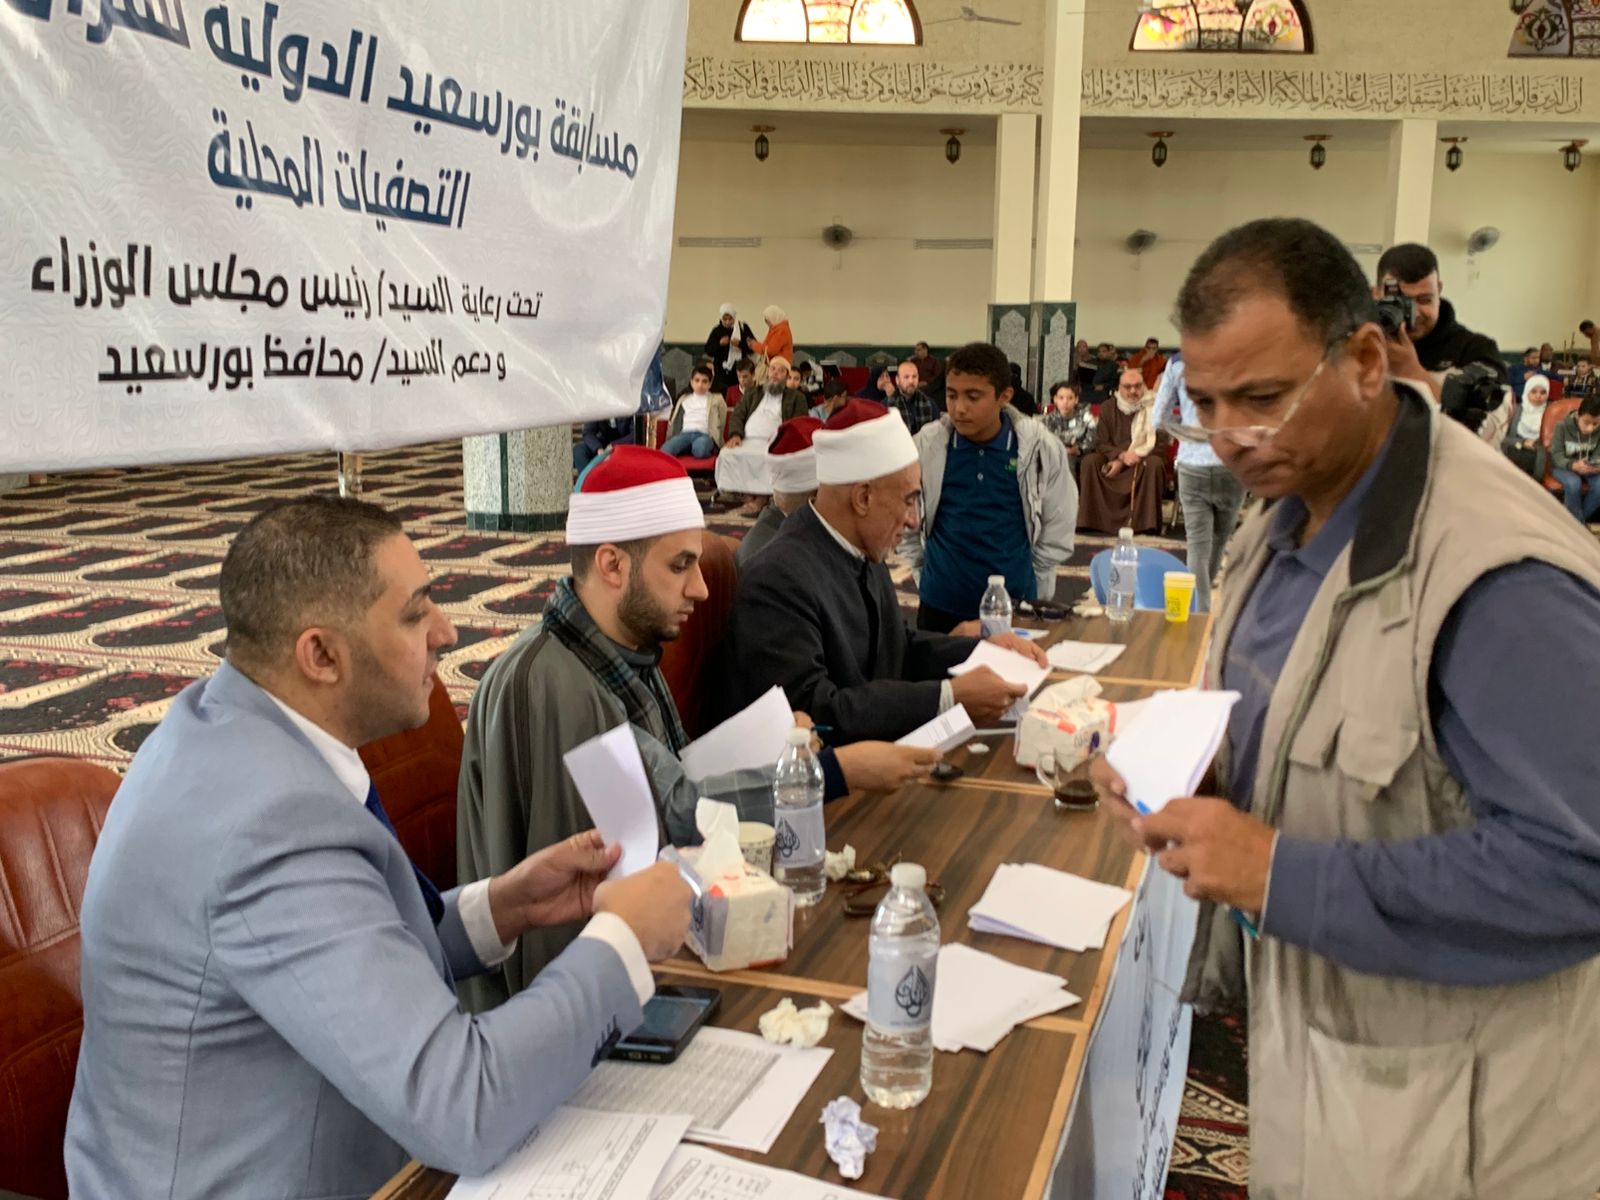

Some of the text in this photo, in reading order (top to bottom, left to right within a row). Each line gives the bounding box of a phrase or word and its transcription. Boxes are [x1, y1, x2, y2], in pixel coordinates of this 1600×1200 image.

[204, 0, 378, 104] الدولية
[386, 65, 541, 163] بورسعيد
[549, 97, 638, 180] مسابقة
[208, 107, 471, 232] التصفيات المحلية
[31, 236, 152, 310] الوزراء
[168, 253, 289, 314] مجلس
[300, 265, 371, 320] رئيس
[461, 283, 501, 324] رعاية
[505, 291, 543, 319] تحت
[98, 342, 253, 395] بورسعيد
[263, 333, 363, 382] محافظ
